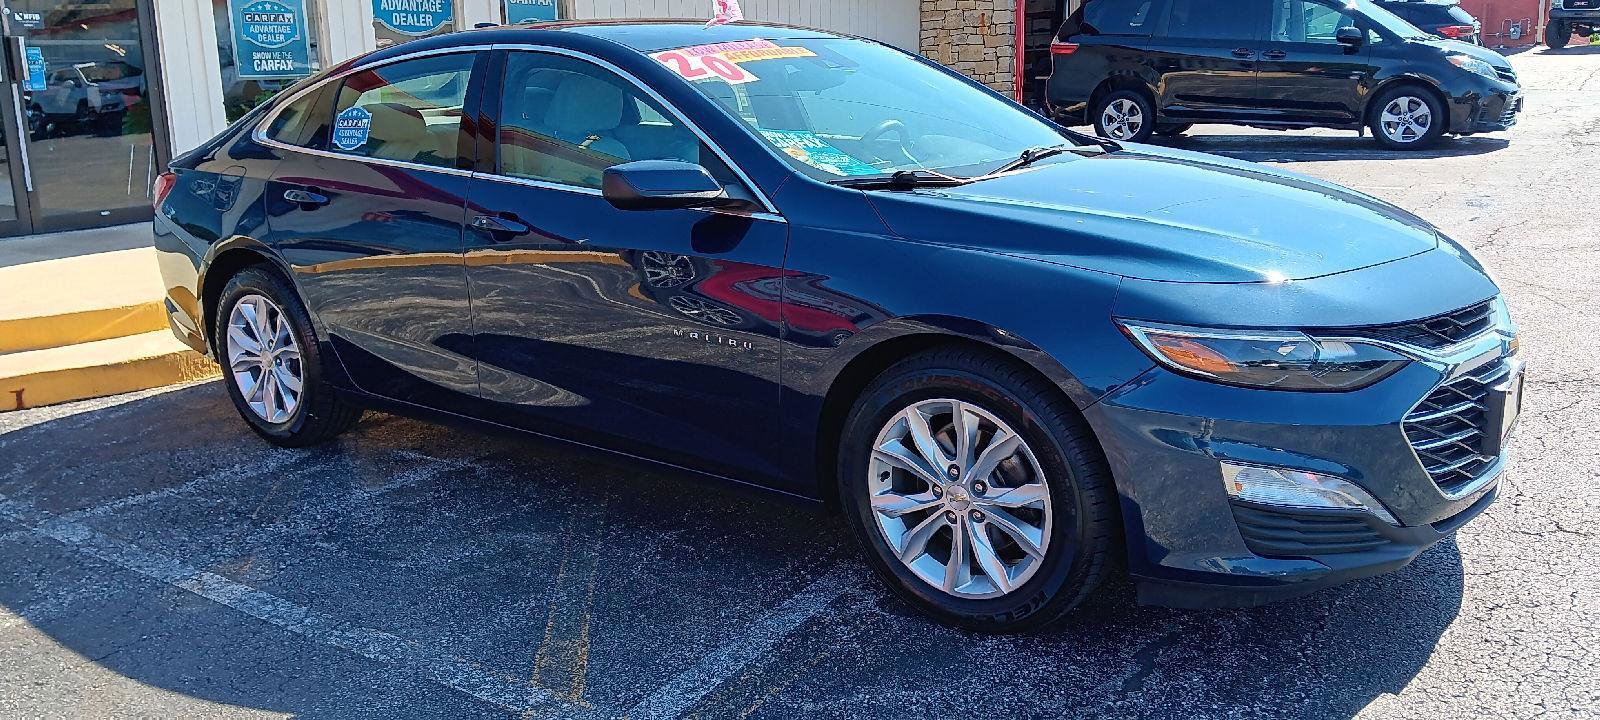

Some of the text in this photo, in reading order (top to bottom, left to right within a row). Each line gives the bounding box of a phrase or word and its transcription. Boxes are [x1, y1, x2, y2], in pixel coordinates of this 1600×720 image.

[381, 0, 442, 13] ADVANTAGE
[244, 13, 293, 23] CARFAX
[392, 13, 433, 26] DEALER
[249, 24, 292, 33] ADVANTAGE
[257, 34, 286, 42] DEALER
[252, 51, 272, 60] SHOW
[272, 51, 281, 60] ME
[253, 59, 294, 71] CARFAX
[656, 52, 744, 81] 20
[673, 329, 752, 350] MALIBU
